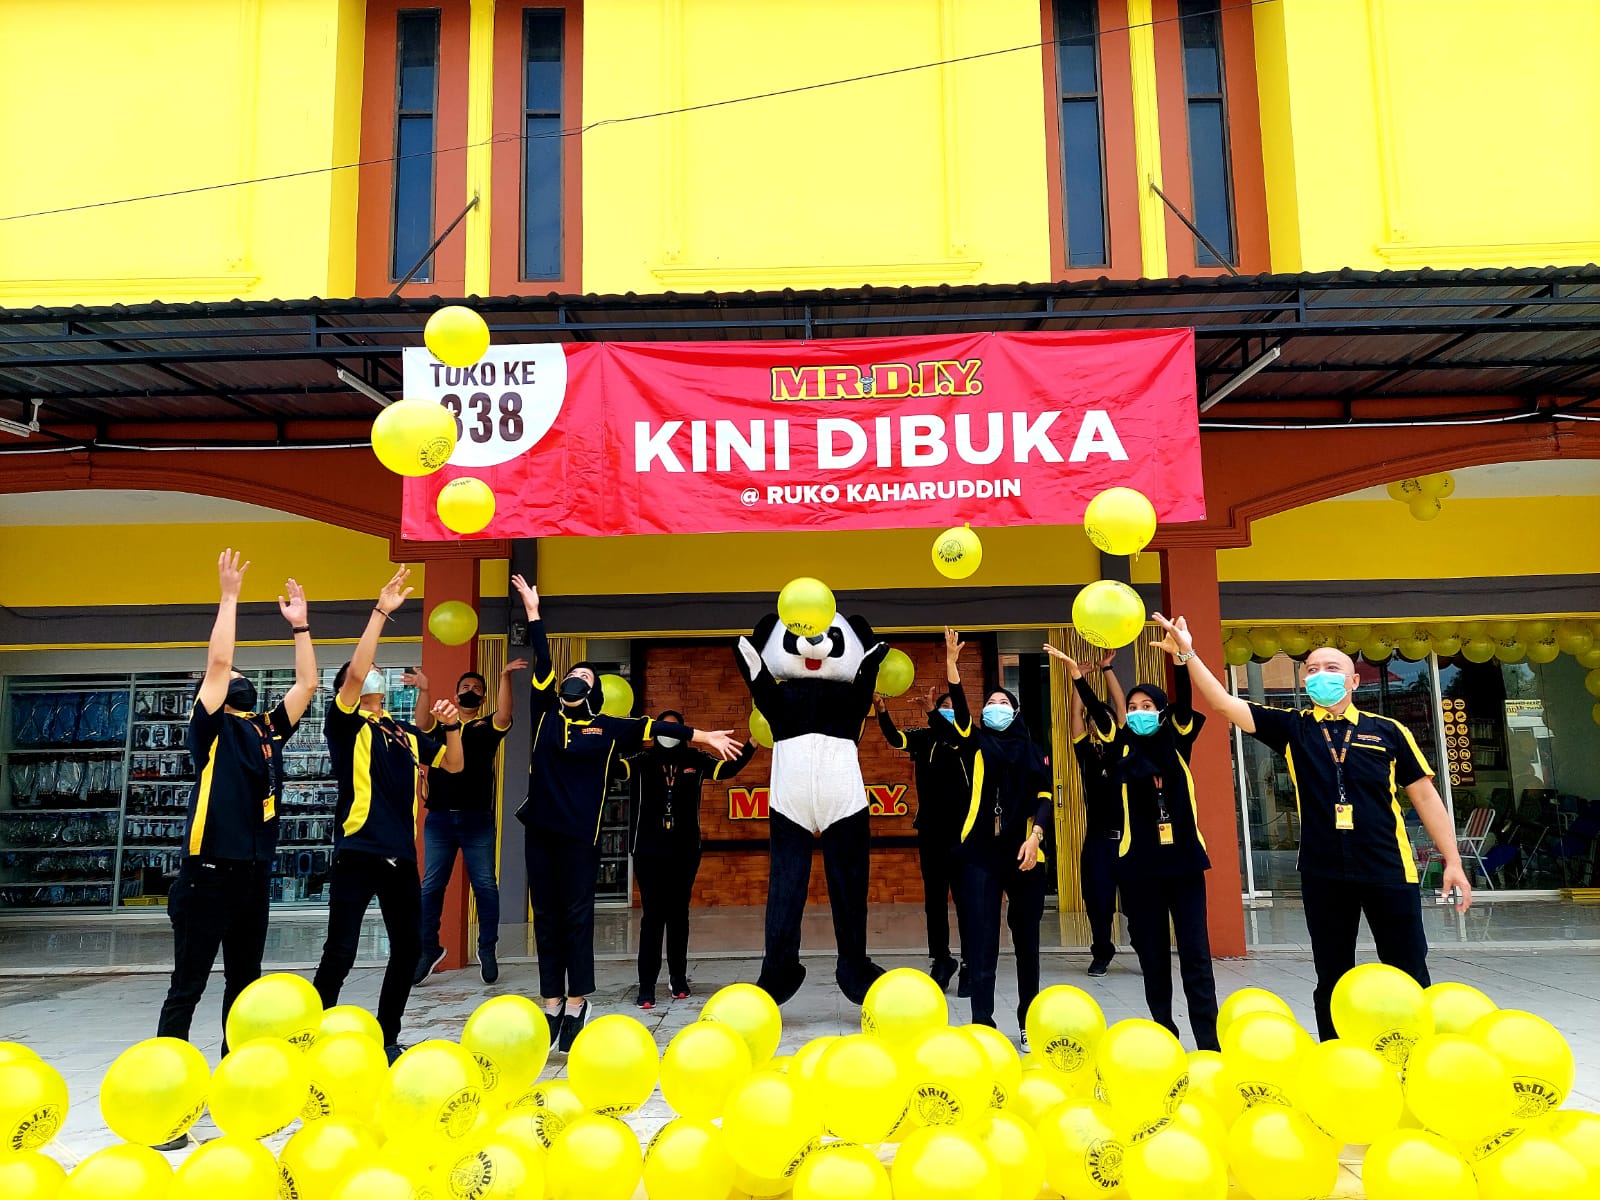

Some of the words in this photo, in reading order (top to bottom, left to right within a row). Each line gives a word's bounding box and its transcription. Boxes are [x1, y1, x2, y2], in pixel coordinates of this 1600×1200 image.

[429, 361, 496, 388] TOKO
[503, 360, 536, 386] KE
[634, 419, 790, 473] KINI
[816, 410, 1129, 470] DIBUKA
[740, 487, 761, 507] @
[767, 484, 841, 505] RUKO
[846, 478, 1022, 503] KAHARUDDIN
